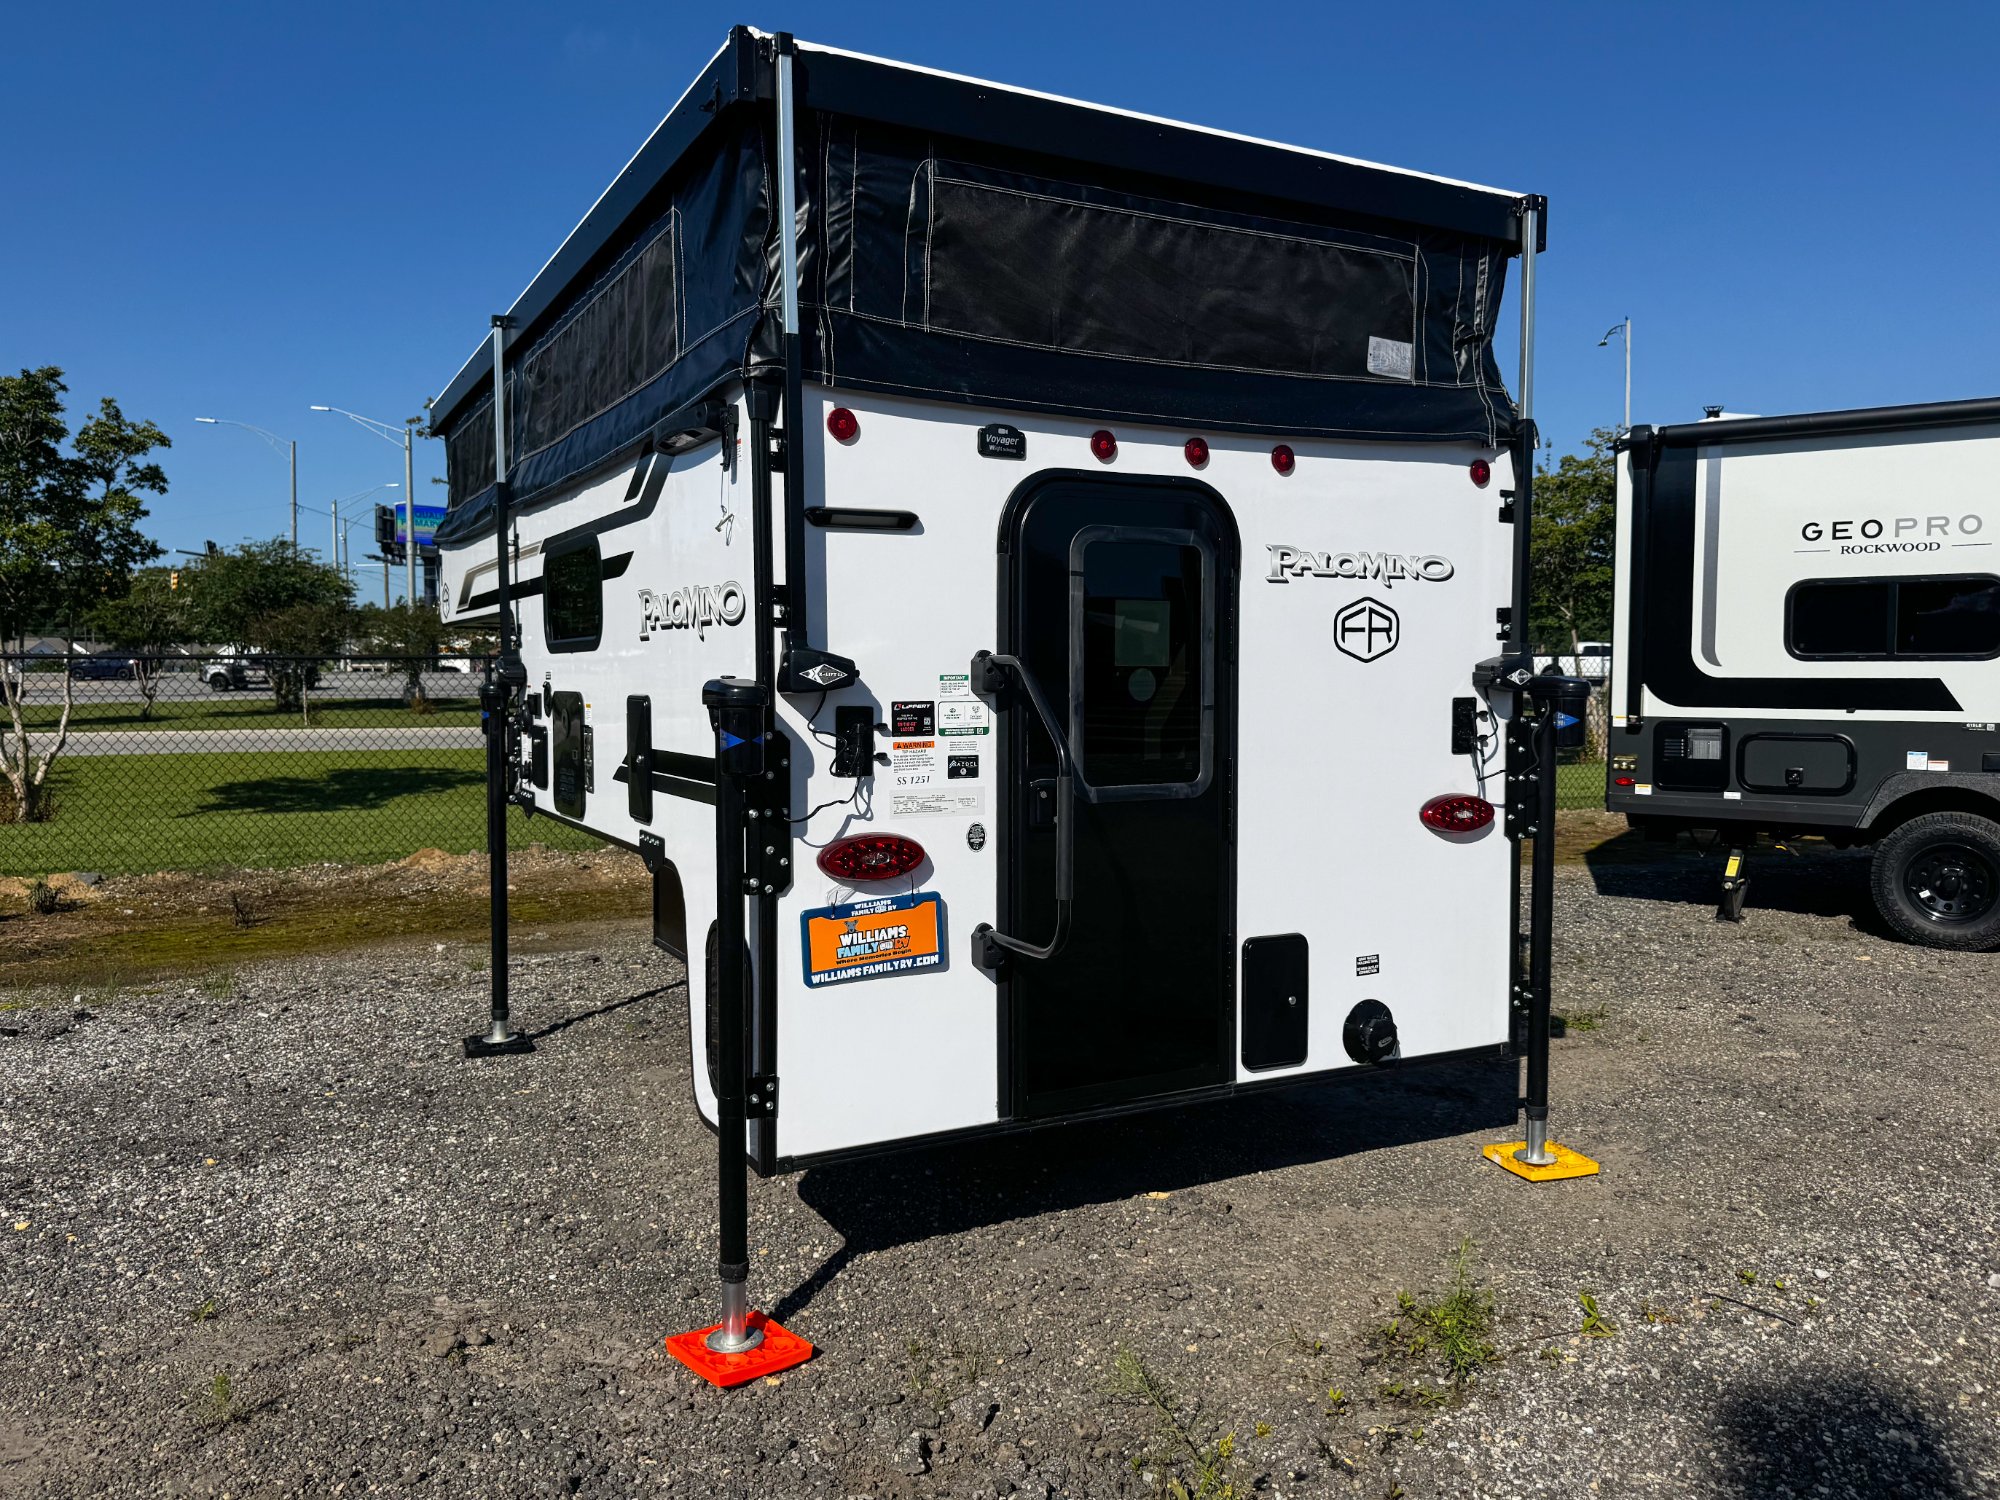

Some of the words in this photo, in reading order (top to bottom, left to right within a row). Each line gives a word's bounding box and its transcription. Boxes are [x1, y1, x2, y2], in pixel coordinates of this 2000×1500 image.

[986, 433, 1020, 446] Voyager
[1840, 541, 1941, 555] ROCKWOOD
[1265, 544, 1454, 589] PALOMINO
[638, 580, 746, 642] PALOMINO
[903, 741, 932, 749] WARNING
[897, 776, 907, 786] SS
[910, 775, 930, 785] 1251
[854, 899, 892, 910] WILLIAMS
[851, 907, 875, 917] FAMILY
[839, 925, 908, 946] WILLIAMS
[836, 940, 879, 959] FAMILY
[894, 936, 911, 950] RV
[835, 956, 858, 965] Where
[859, 952, 892, 962] Memories
[892, 948, 912, 956] Begin
